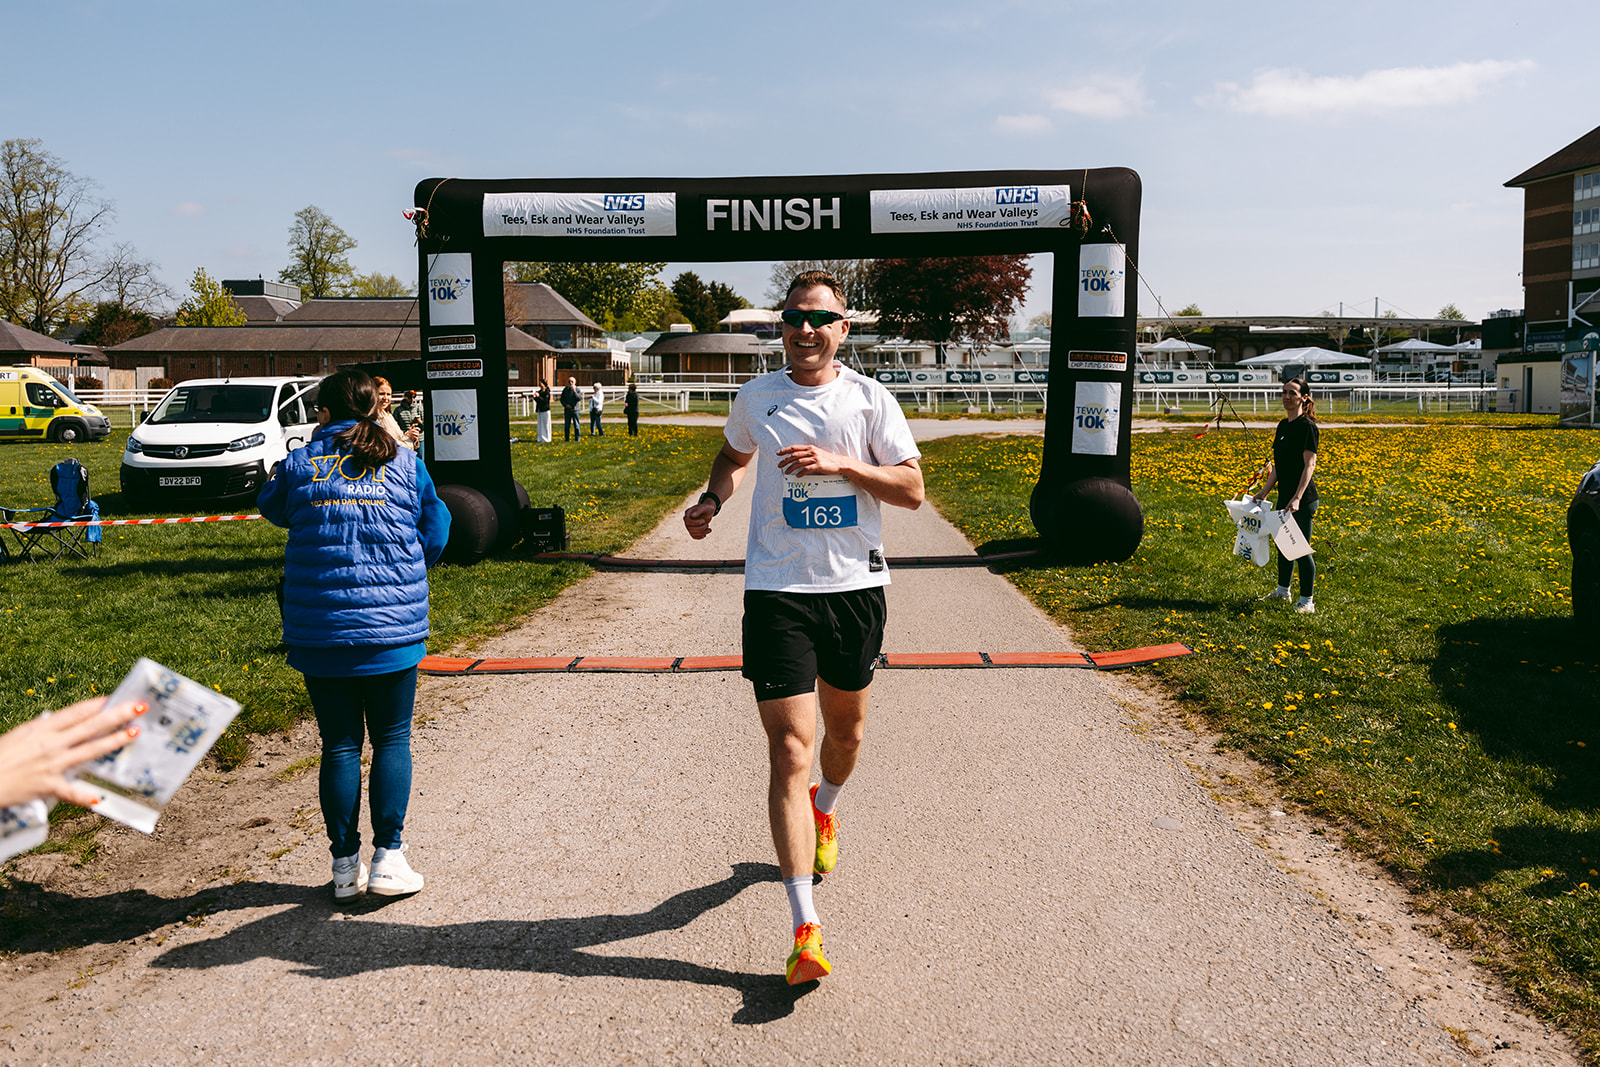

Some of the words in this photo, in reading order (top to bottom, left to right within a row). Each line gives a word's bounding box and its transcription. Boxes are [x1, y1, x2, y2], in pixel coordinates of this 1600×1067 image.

[997, 188, 1037, 203] NHS
[605, 195, 643, 210] NHS
[502, 214, 528, 226] Tees,
[531, 214, 549, 225] Esk
[552, 214, 572, 225] and
[575, 215, 604, 225] Wear
[607, 214, 645, 227] Valleys
[706, 197, 841, 231] FINISH
[890, 211, 917, 222] Tees,
[921, 210, 939, 220] Esk
[942, 210, 963, 219] and
[966, 209, 996, 219] Wear
[1000, 207, 1038, 218] Valleys
[957, 221, 973, 229] NHS
[975, 220, 1018, 228] Foundation
[1020, 219, 1038, 227] Trust
[584, 227, 626, 235] Foundation
[1081, 269, 1107, 278] TEWV
[430, 278, 453, 287] TEWV
[1081, 278, 1111, 291] 10k
[430, 287, 458, 300] 10k
[1076, 406, 1102, 415] TEWV
[434, 414, 458, 422] TEWV
[1075, 415, 1105, 429] 10k
[435, 422, 462, 436] 10k
[164, 477, 184, 485] DV22
[347, 484, 386, 495] RADIO
[787, 487, 809, 498] 10k
[341, 498, 357, 506] DAB
[358, 498, 387, 506] ONLINE
[801, 505, 842, 526] 163
[1243, 546, 1252, 560] 0k
